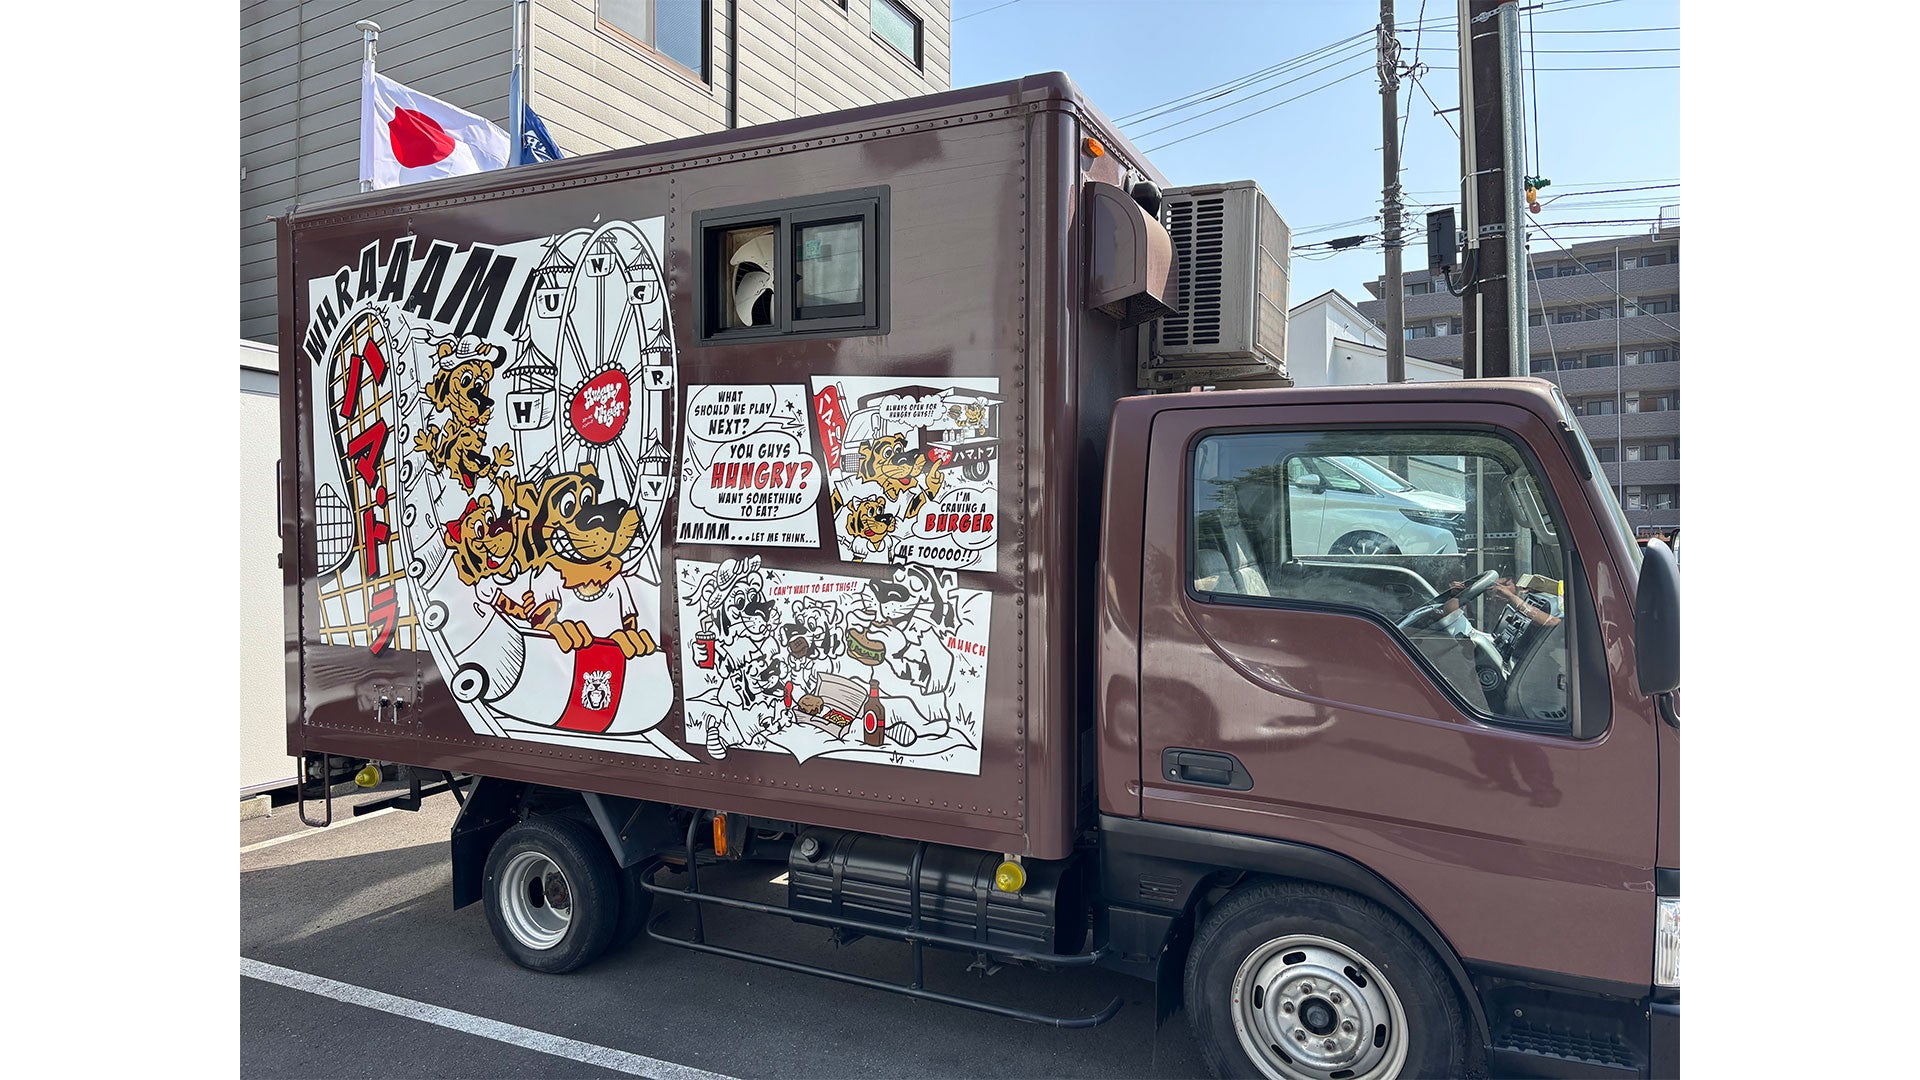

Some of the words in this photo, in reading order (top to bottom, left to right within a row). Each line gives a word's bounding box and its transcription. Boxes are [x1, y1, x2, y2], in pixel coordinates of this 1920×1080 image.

[513, 402, 533, 424] H
[544, 293, 560, 312] U
[647, 482, 663, 497] Y
[718, 391, 743, 402] WHAT
[694, 404, 729, 416] SHOULD
[733, 404, 746, 415] WE
[749, 402, 772, 415] PLAY
[708, 418, 750, 436] NEXT?
[730, 444, 754, 458] YOU
[758, 443, 791, 458] GUYS
[710, 461, 813, 490] HUNGRY?
[718, 493, 743, 504] WANT
[746, 492, 802, 505] SOMETHING
[955, 492, 971, 501] I'M
[741, 506, 753, 517] TO
[756, 506, 779, 517] EAT?
[940, 502, 978, 513] CRAVING
[980, 503, 986, 513] A
[925, 513, 994, 533] BURGER
[751, 532, 765, 542] LET
[767, 532, 779, 542] ME
[782, 532, 817, 544] THINK...
[899, 545, 914, 557] ME
[918, 546, 973, 563] TOOOOO!!
[773, 585, 793, 596] CAN'T
[794, 585, 810, 594] WAIT
[811, 584, 820, 593] TO
[822, 583, 834, 592] EAT
[836, 581, 858, 592] THIS!!
[947, 636, 987, 656] MUNCH
